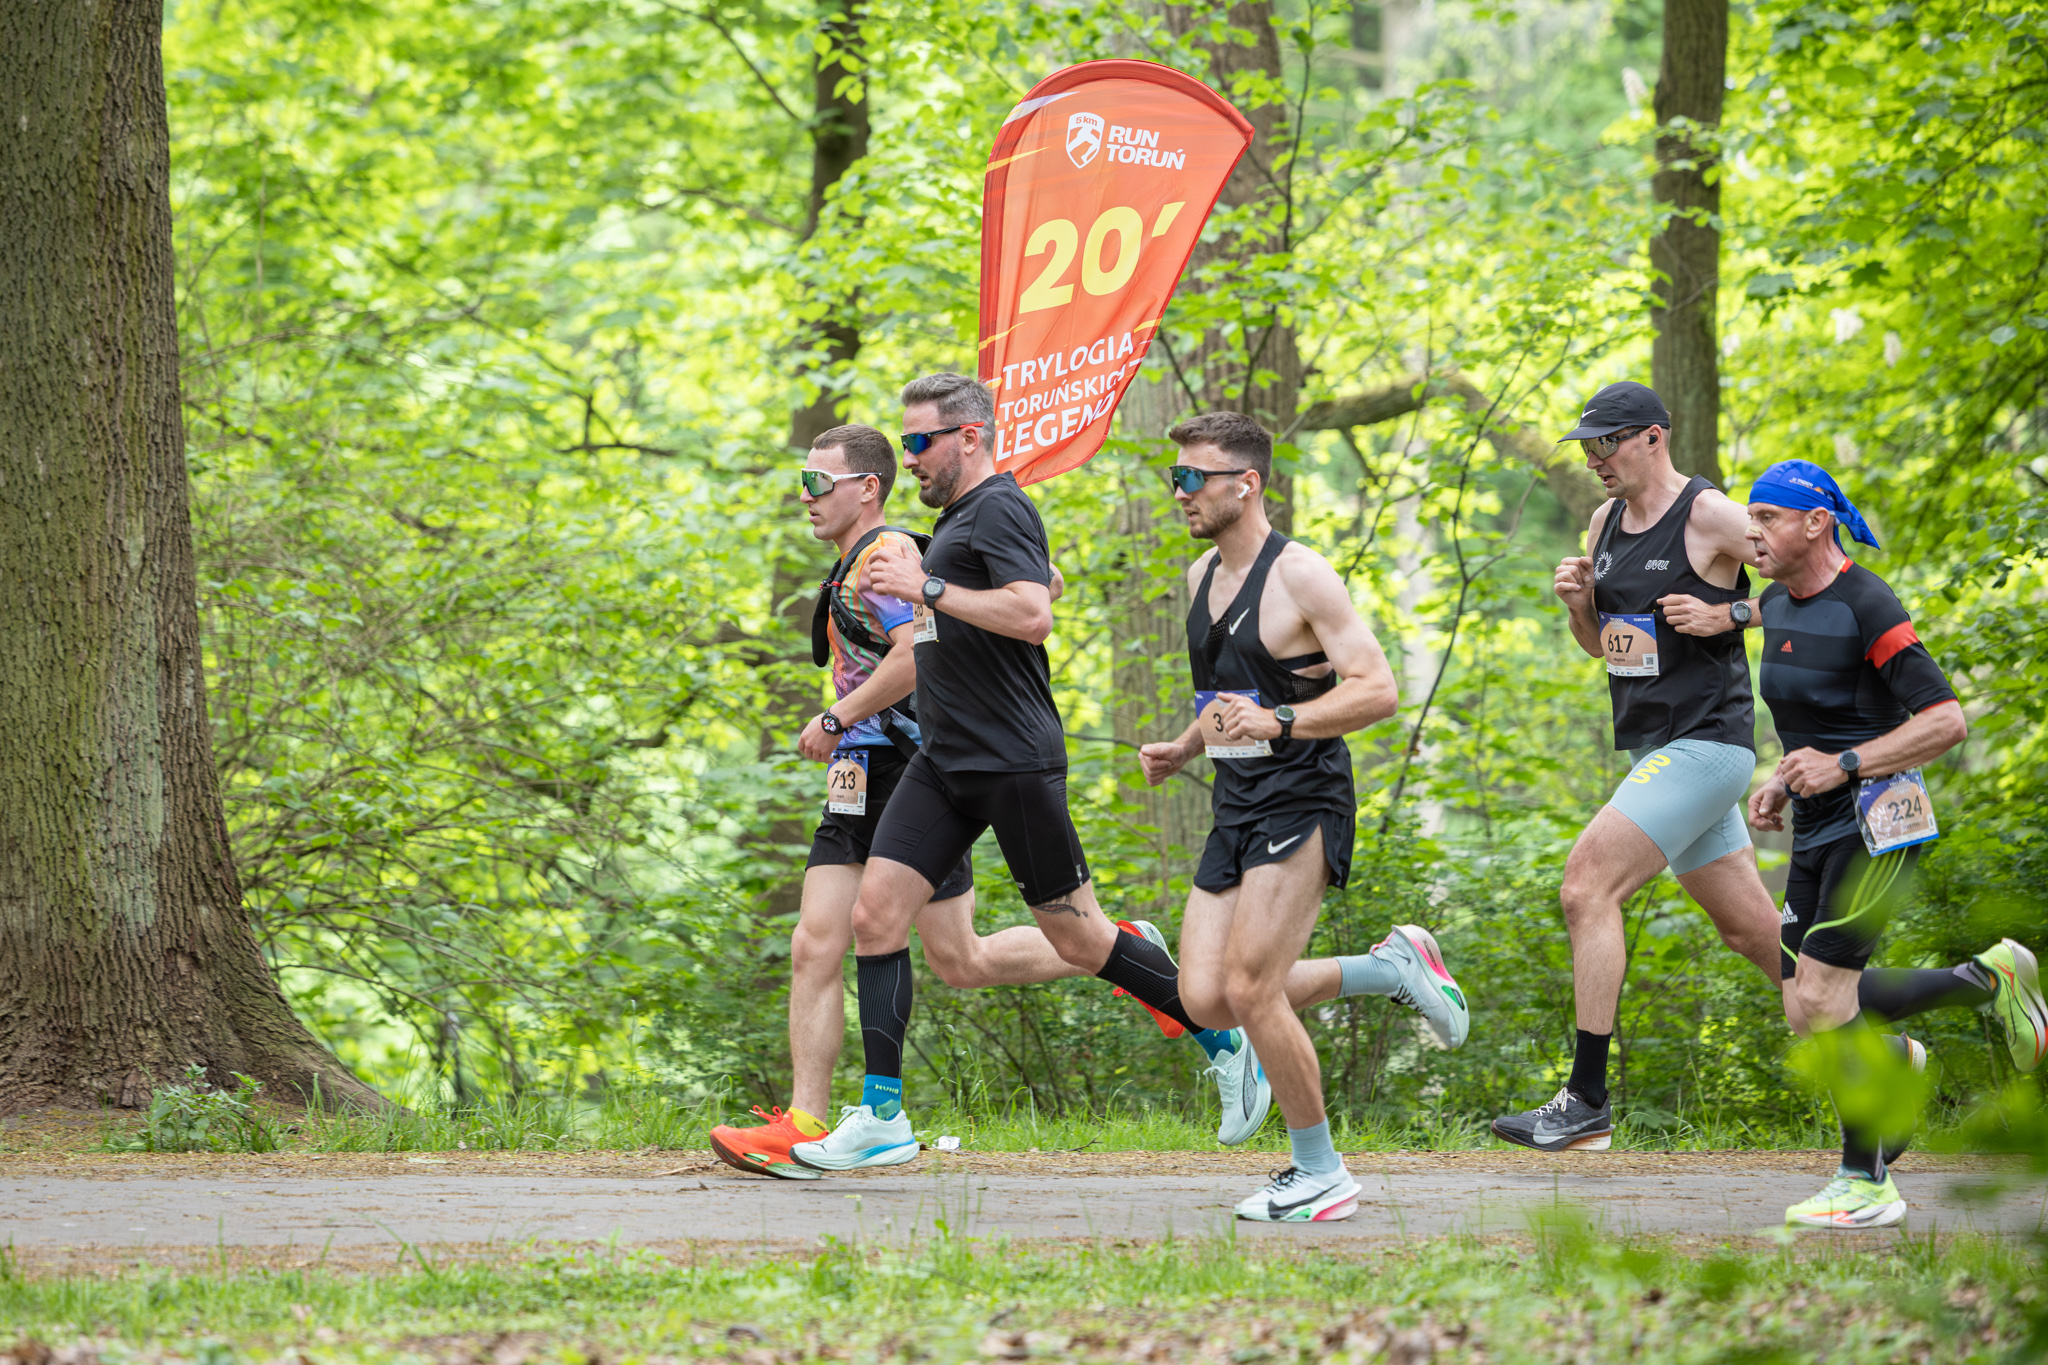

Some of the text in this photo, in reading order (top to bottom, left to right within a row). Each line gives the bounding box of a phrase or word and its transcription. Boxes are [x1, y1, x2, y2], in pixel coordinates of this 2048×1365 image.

[1075, 116, 1098, 127] 5 km
[1108, 125, 1160, 148] RUN
[1106, 143, 1186, 170] TORUŃ
[1002, 332, 1133, 390] TRYLOGIA
[995, 390, 1115, 462] LEGEND
[1608, 633, 1634, 653] 617
[831, 770, 856, 790] 713
[1628, 753, 1671, 784] UVU
[1888, 795, 1923, 822] 224
